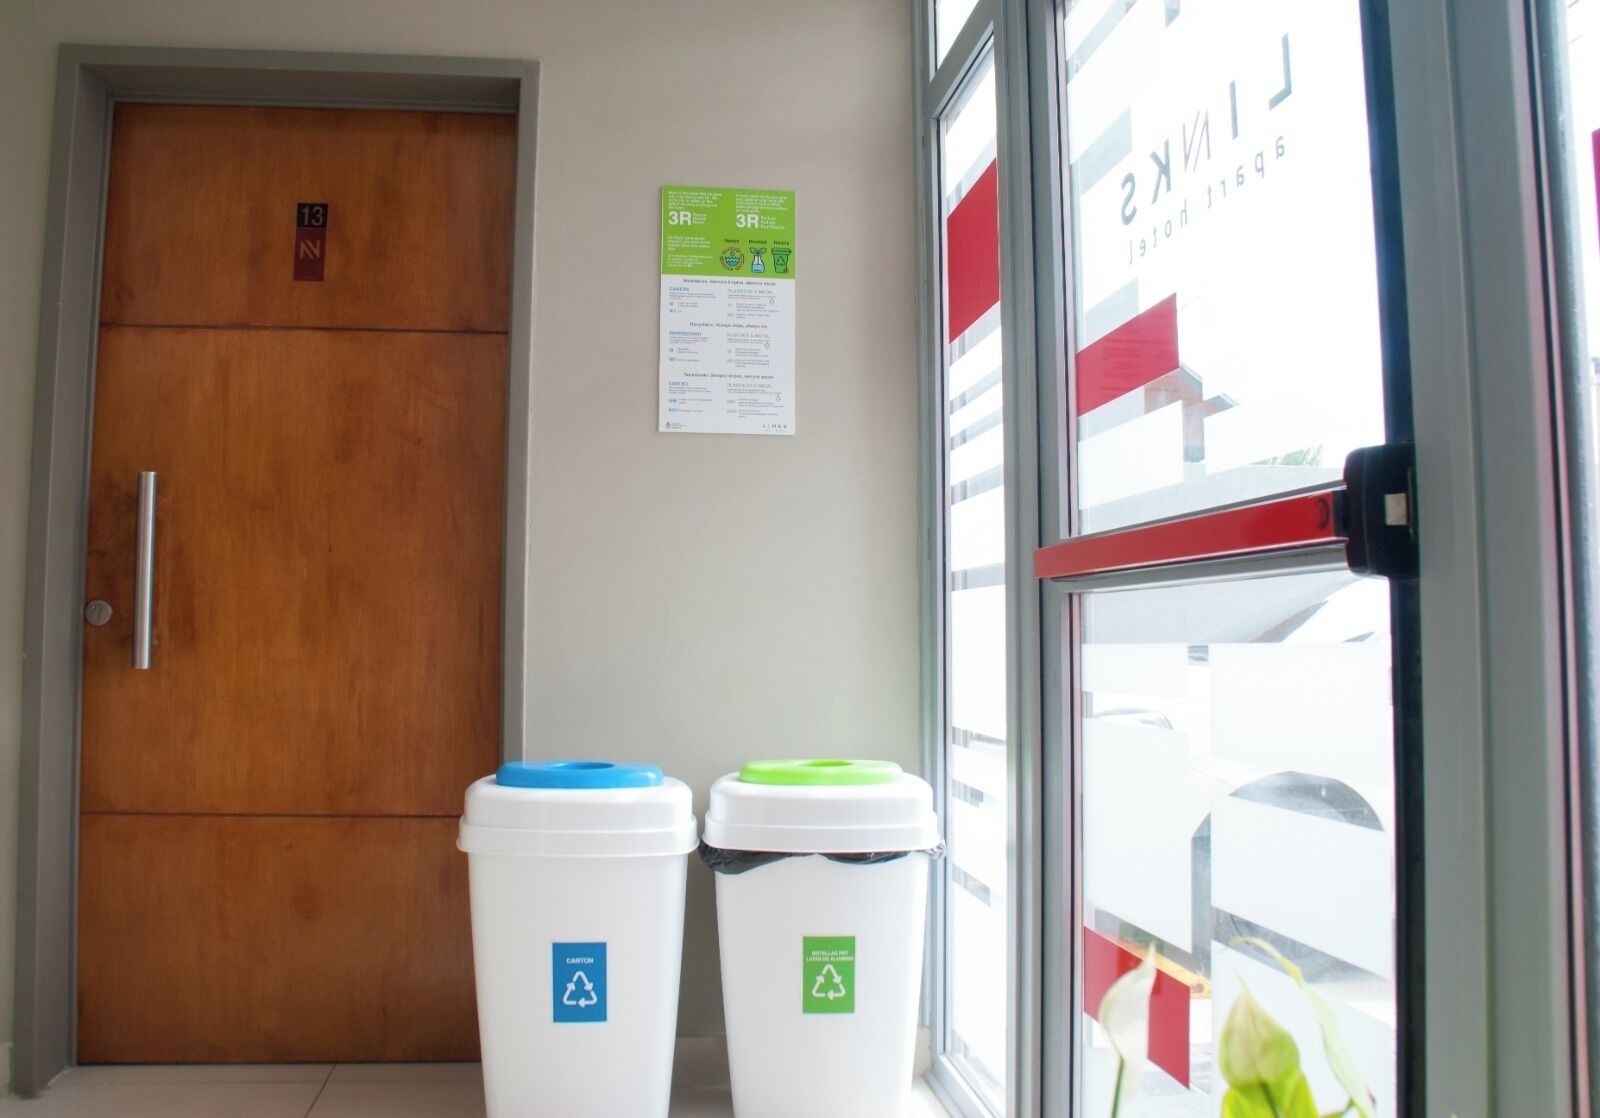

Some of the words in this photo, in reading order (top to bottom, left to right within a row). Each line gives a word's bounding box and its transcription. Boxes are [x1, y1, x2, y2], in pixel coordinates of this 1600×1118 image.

[301, 206, 324, 226] 13
[668, 211, 692, 225] 3R
[736, 214, 759, 228] 3R
